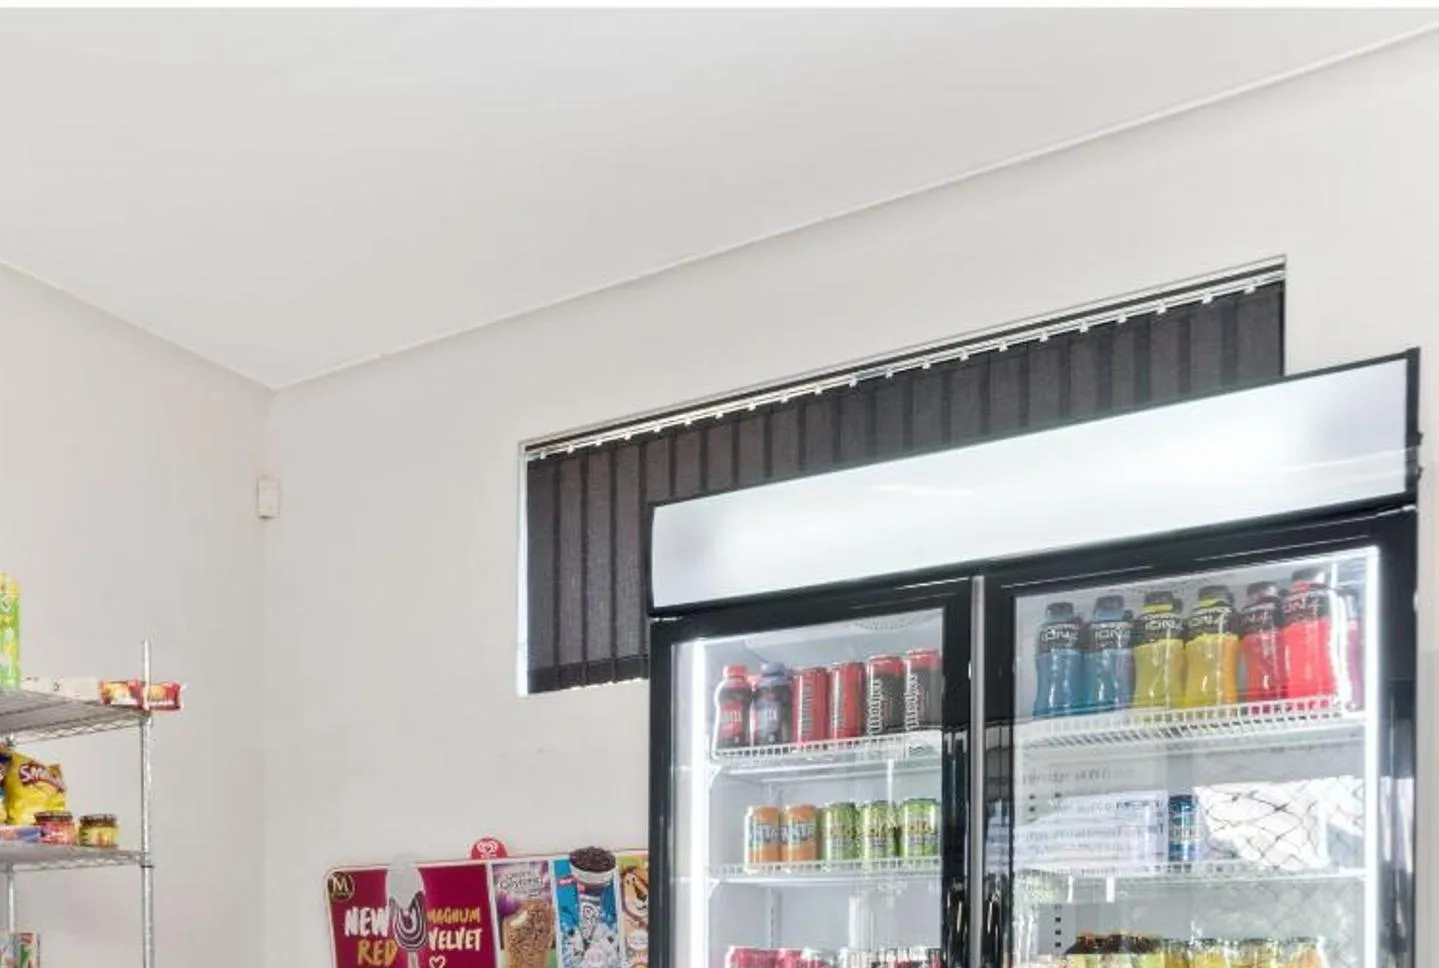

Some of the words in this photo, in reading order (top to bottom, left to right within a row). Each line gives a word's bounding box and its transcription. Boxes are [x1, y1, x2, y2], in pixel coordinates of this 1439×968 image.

[344, 905, 390, 938] NEW
[425, 907, 482, 925] MAGNUM
[357, 938, 399, 968] RED
[427, 927, 483, 952] VELVET
